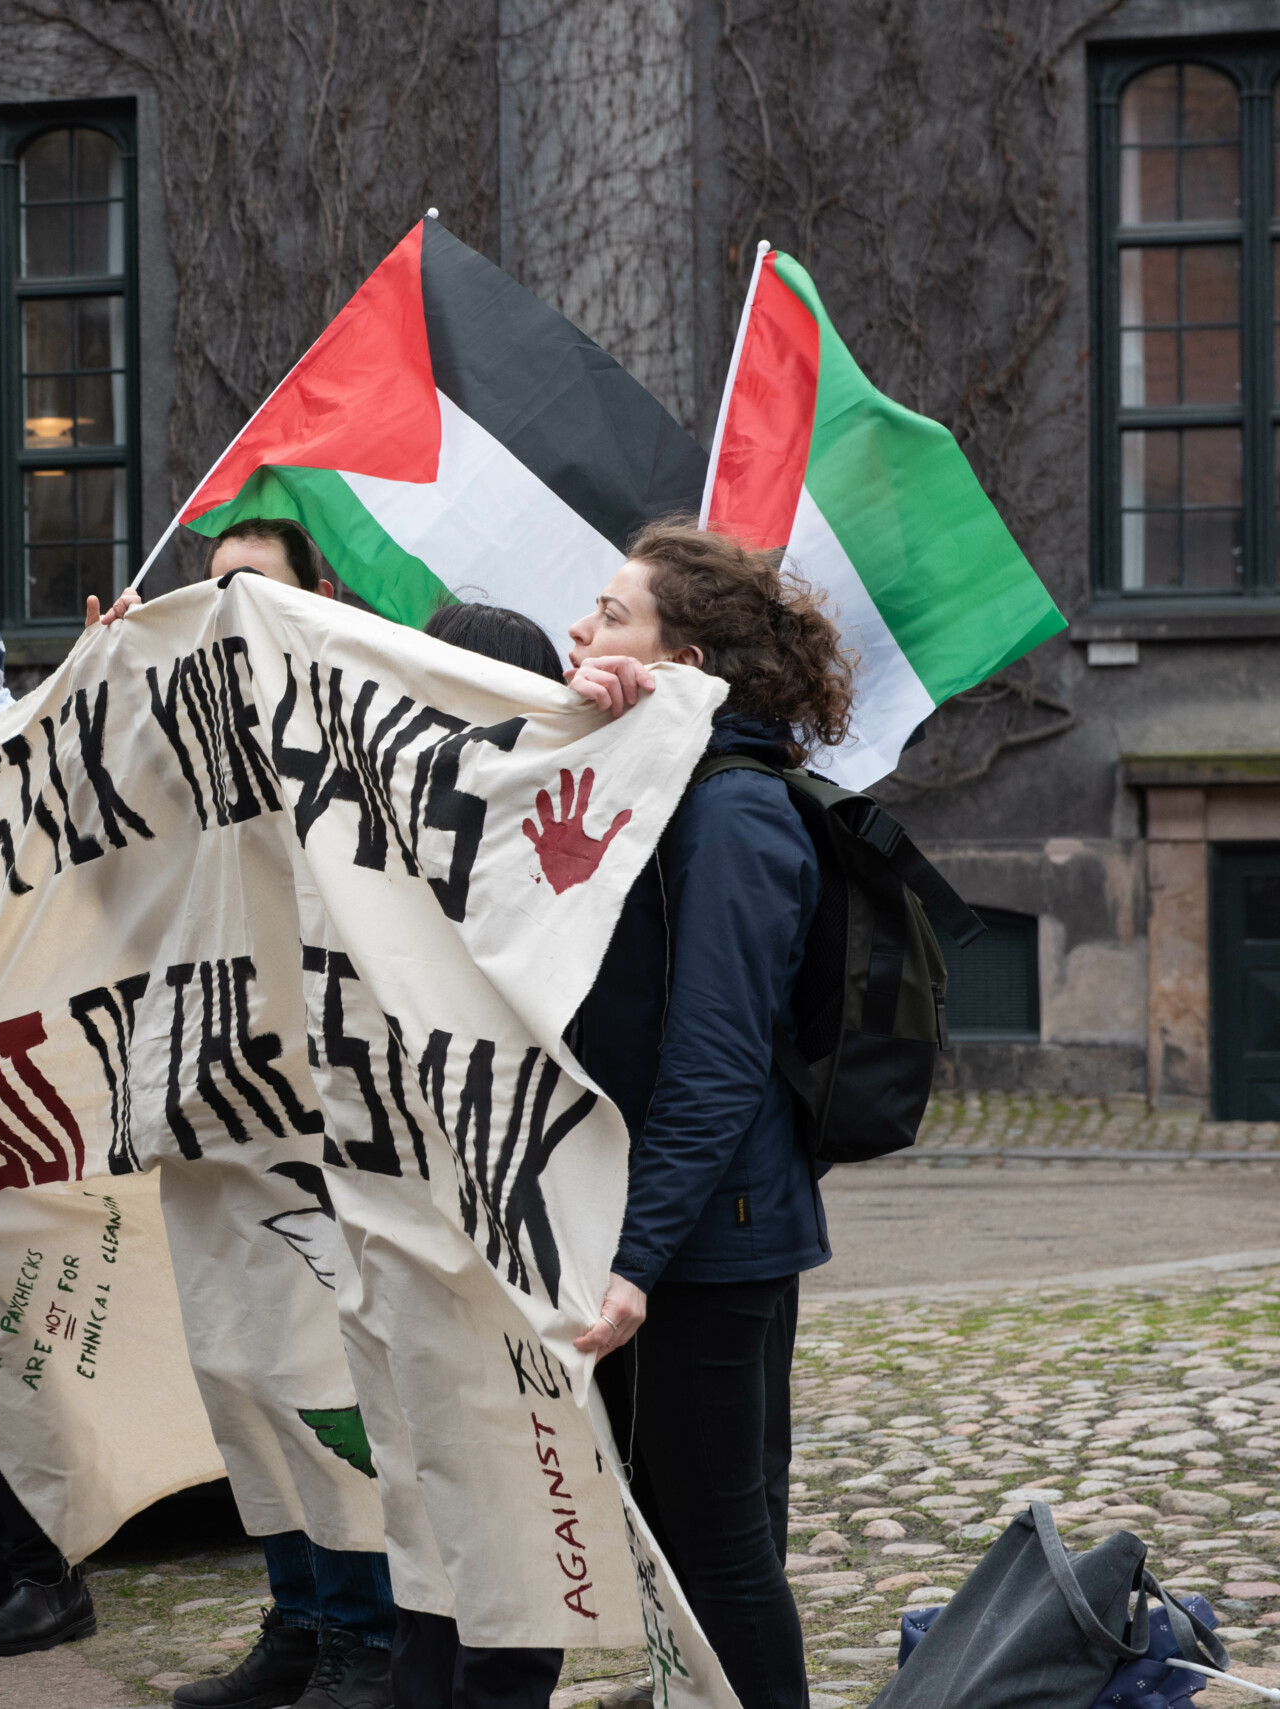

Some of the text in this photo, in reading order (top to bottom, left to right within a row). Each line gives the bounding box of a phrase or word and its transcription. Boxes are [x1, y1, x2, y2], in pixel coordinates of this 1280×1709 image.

[165, 955, 325, 1161] THE
[0, 1247, 44, 1335] PAYCHECKS
[21, 1254, 80, 1392] ARE NOT FOR
[76, 1283, 111, 1380] ETHNICAL
[531, 1411, 599, 1621] AGAINST
